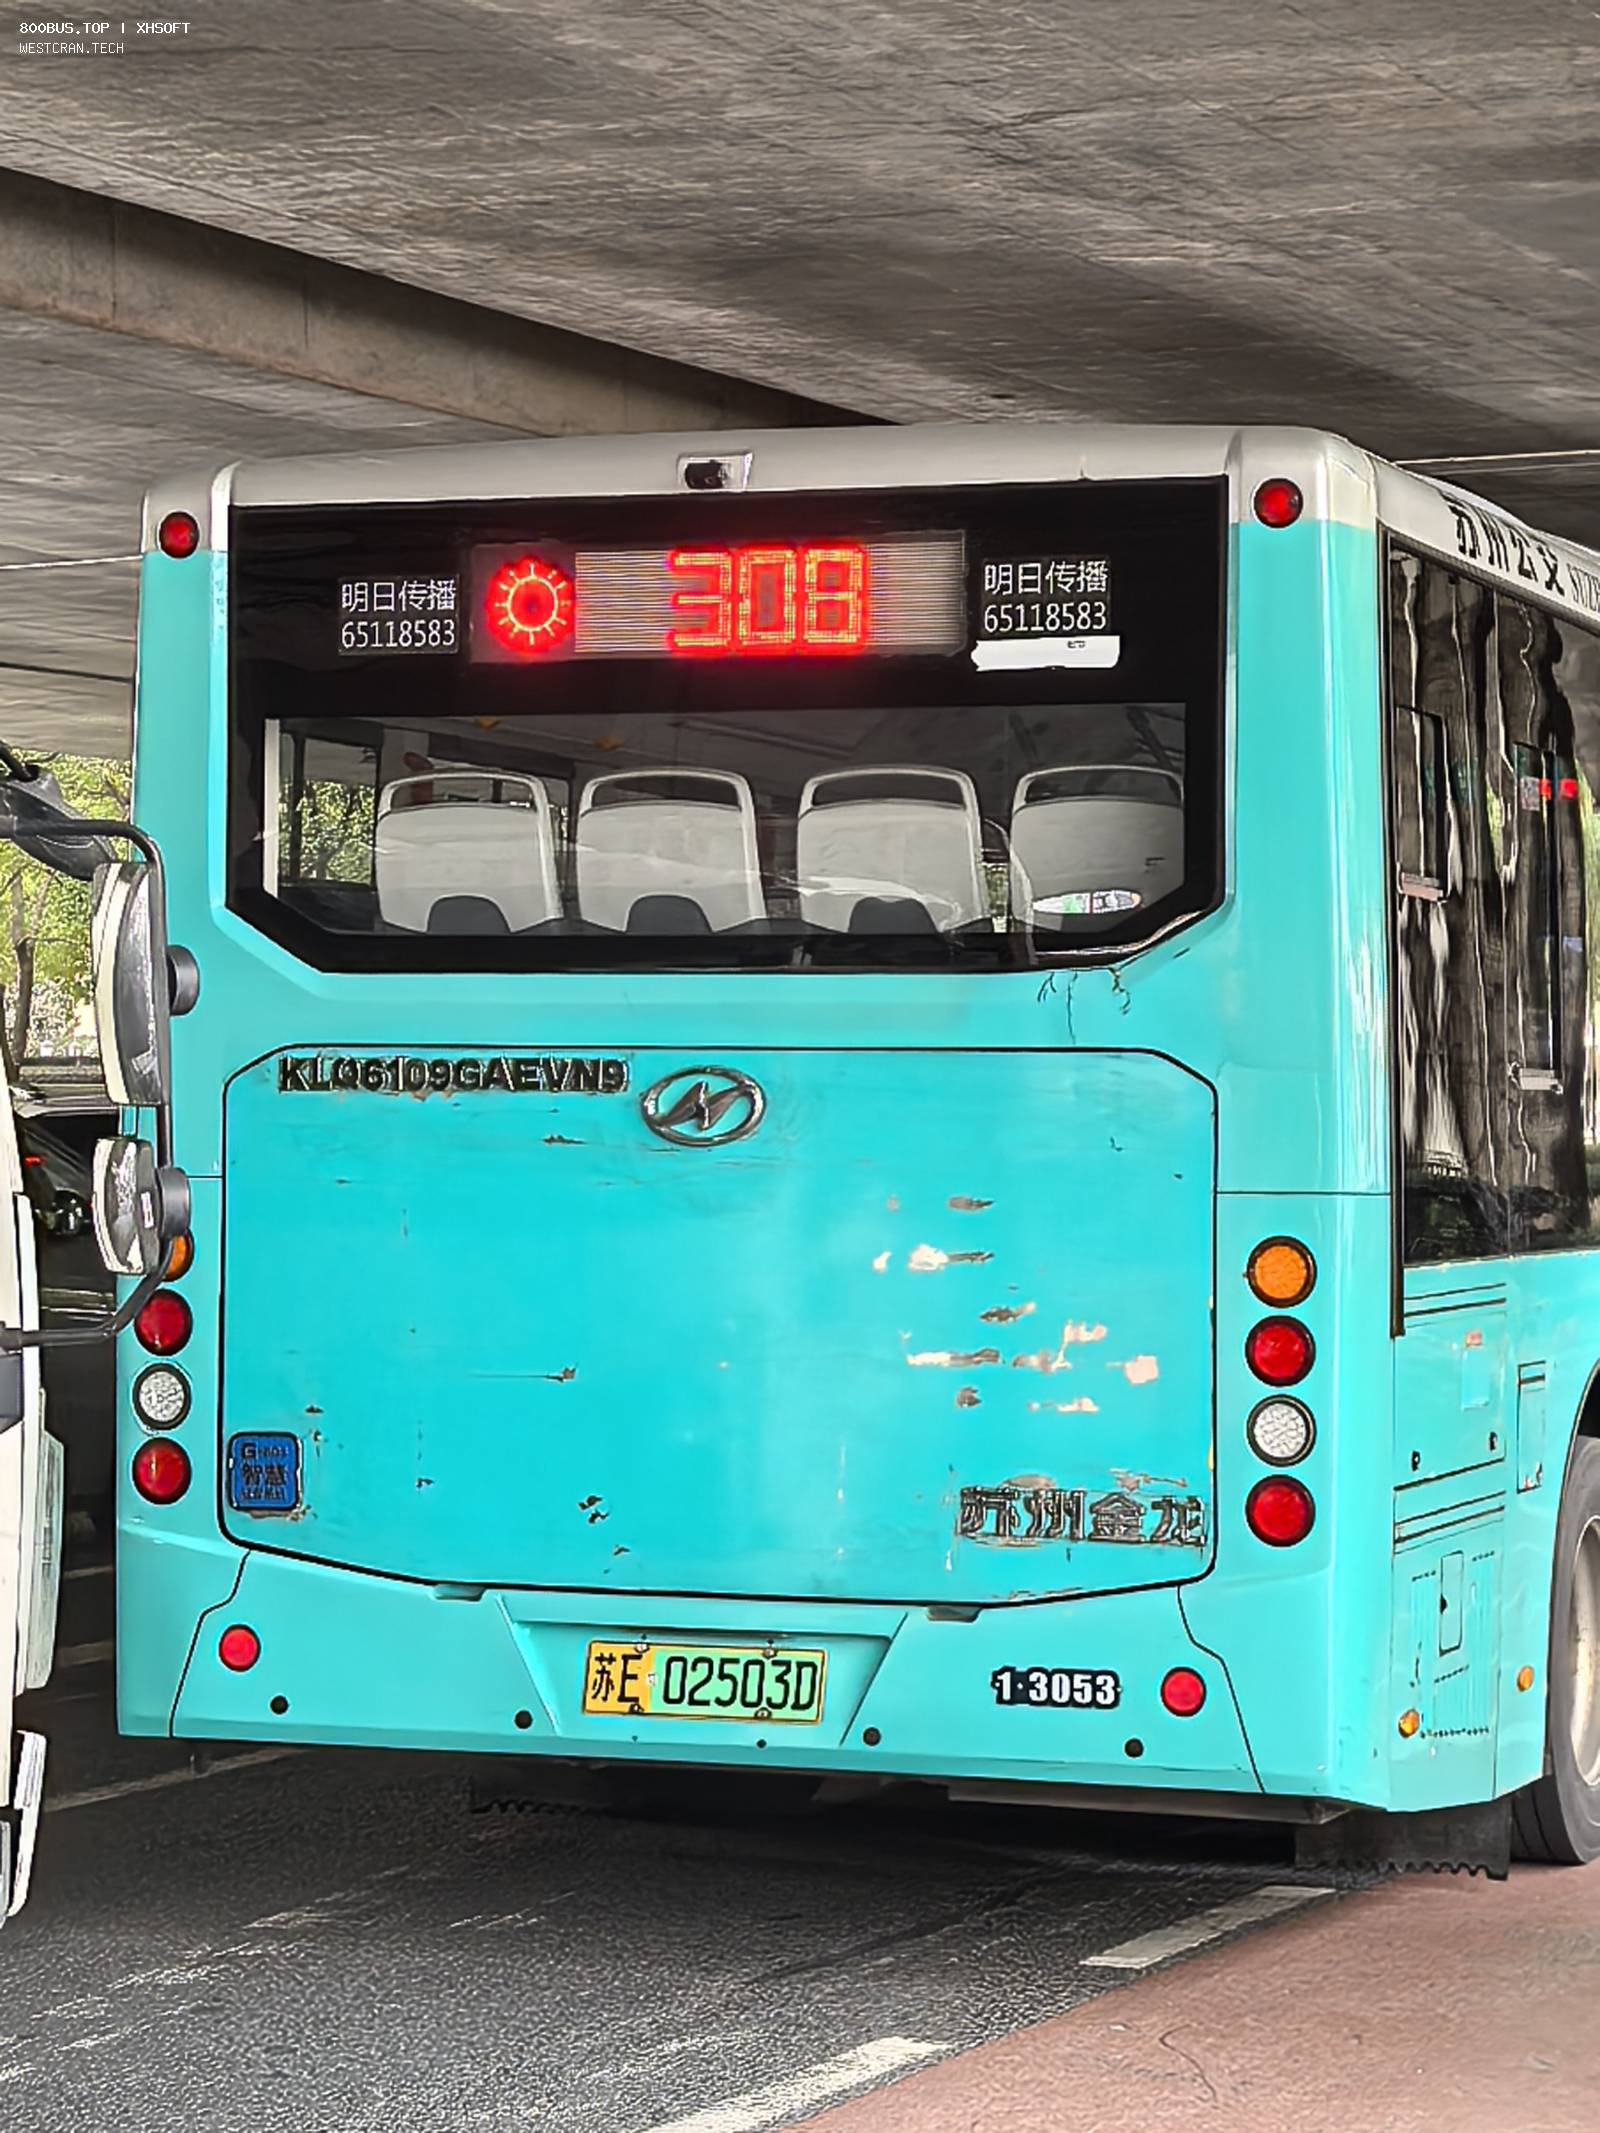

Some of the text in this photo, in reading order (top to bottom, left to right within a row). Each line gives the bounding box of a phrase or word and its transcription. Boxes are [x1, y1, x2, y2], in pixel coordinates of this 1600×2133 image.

[341, 579, 457, 613] 明日传播
[983, 560, 1109, 596] 明日传播
[670, 545, 866, 649] 308
[341, 619, 456, 649] 65118583
[983, 600, 1108, 633] 65118583
[279, 1056, 629, 1093] KLQ6109GAEVN9
[958, 1486, 1207, 1547] 苏州金龙
[591, 1652, 819, 1712] 苏E 02503D
